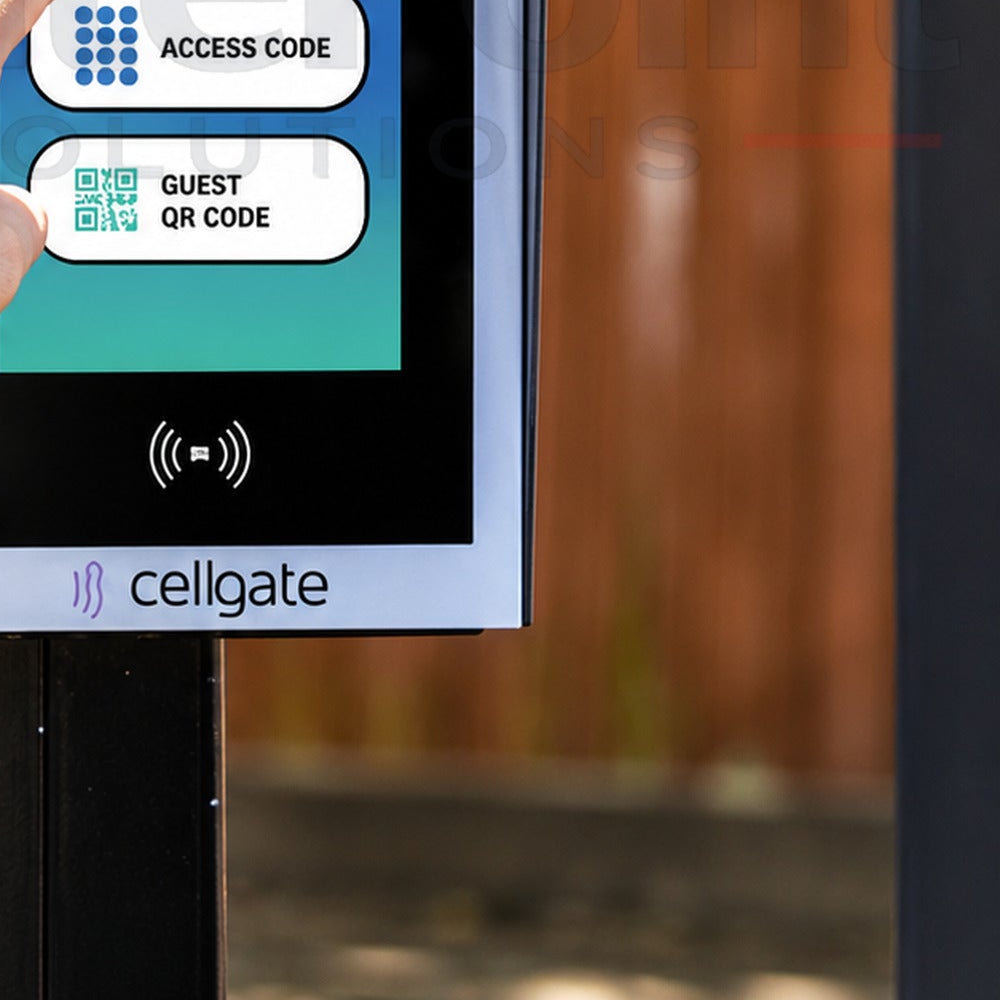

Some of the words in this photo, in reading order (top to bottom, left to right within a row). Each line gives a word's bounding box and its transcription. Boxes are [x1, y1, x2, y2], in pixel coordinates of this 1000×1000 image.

[160, 37, 257, 59] ACCESS
[264, 37, 331, 59] CODE
[160, 174, 242, 196] GUEST
[160, 206, 196, 230] QR
[203, 206, 270, 228] CODE
[130, 559, 329, 618] cellgate
